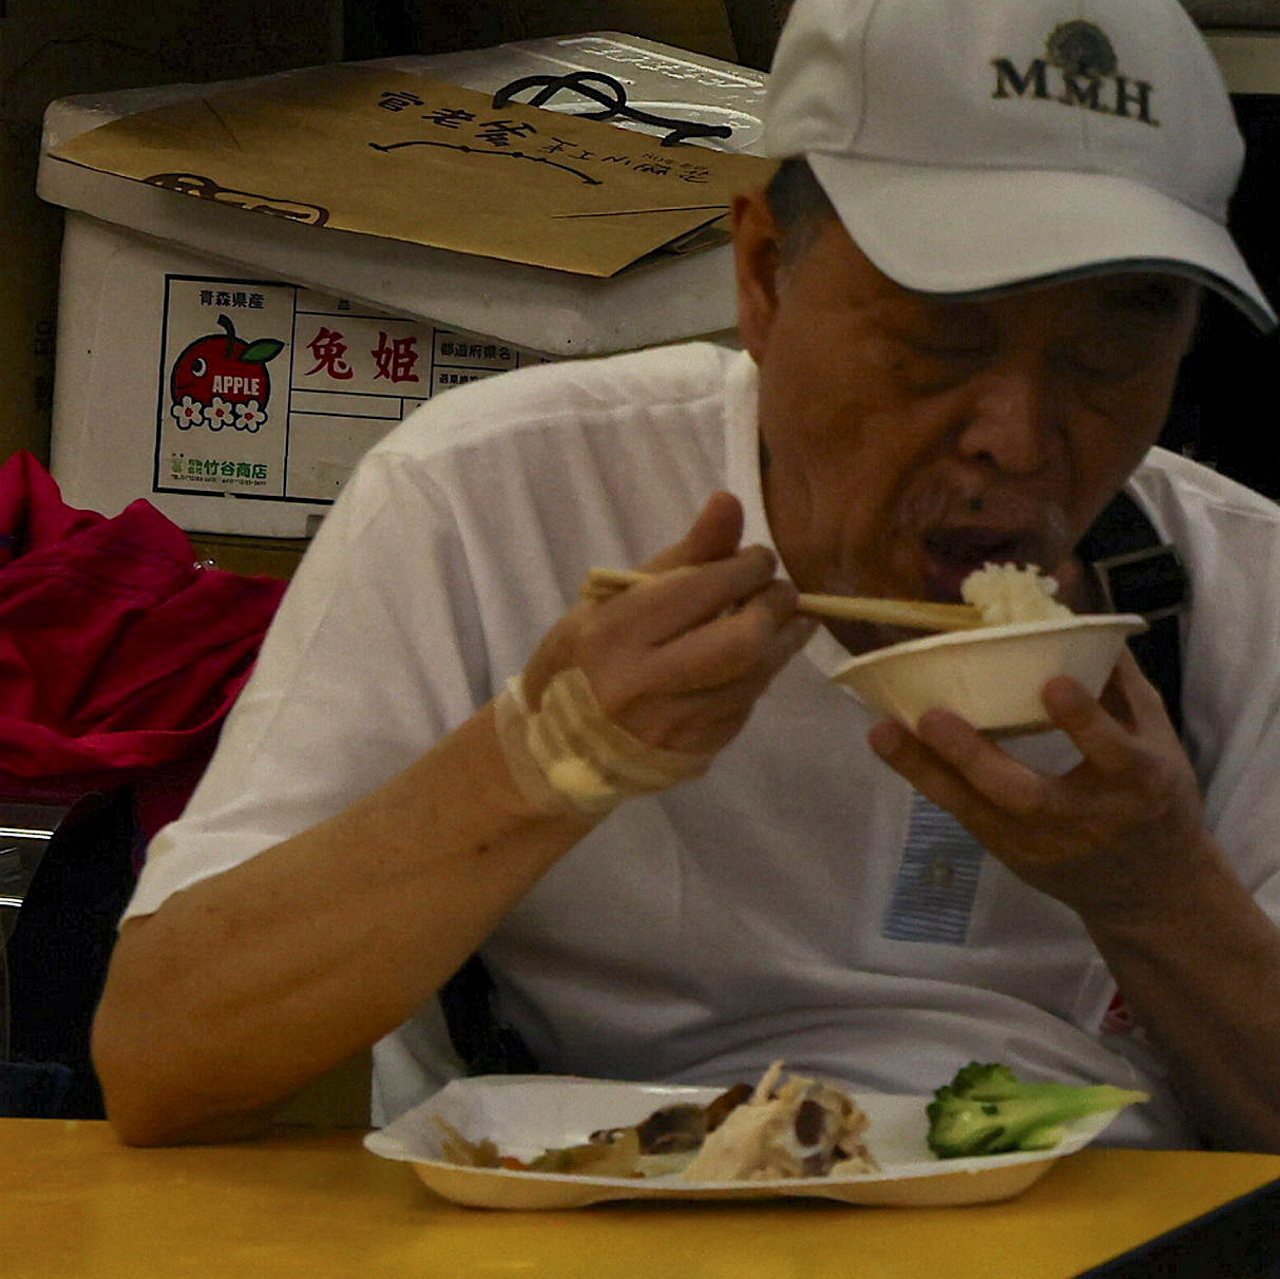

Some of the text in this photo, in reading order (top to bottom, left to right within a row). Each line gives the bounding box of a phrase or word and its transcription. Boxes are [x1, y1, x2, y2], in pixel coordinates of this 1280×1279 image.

[990, 57, 1162, 128] MMH
[199, 290, 265, 310] 青森県産
[212, 375, 260, 396] APPLE
[204, 460, 268, 479] 竹谷商店
